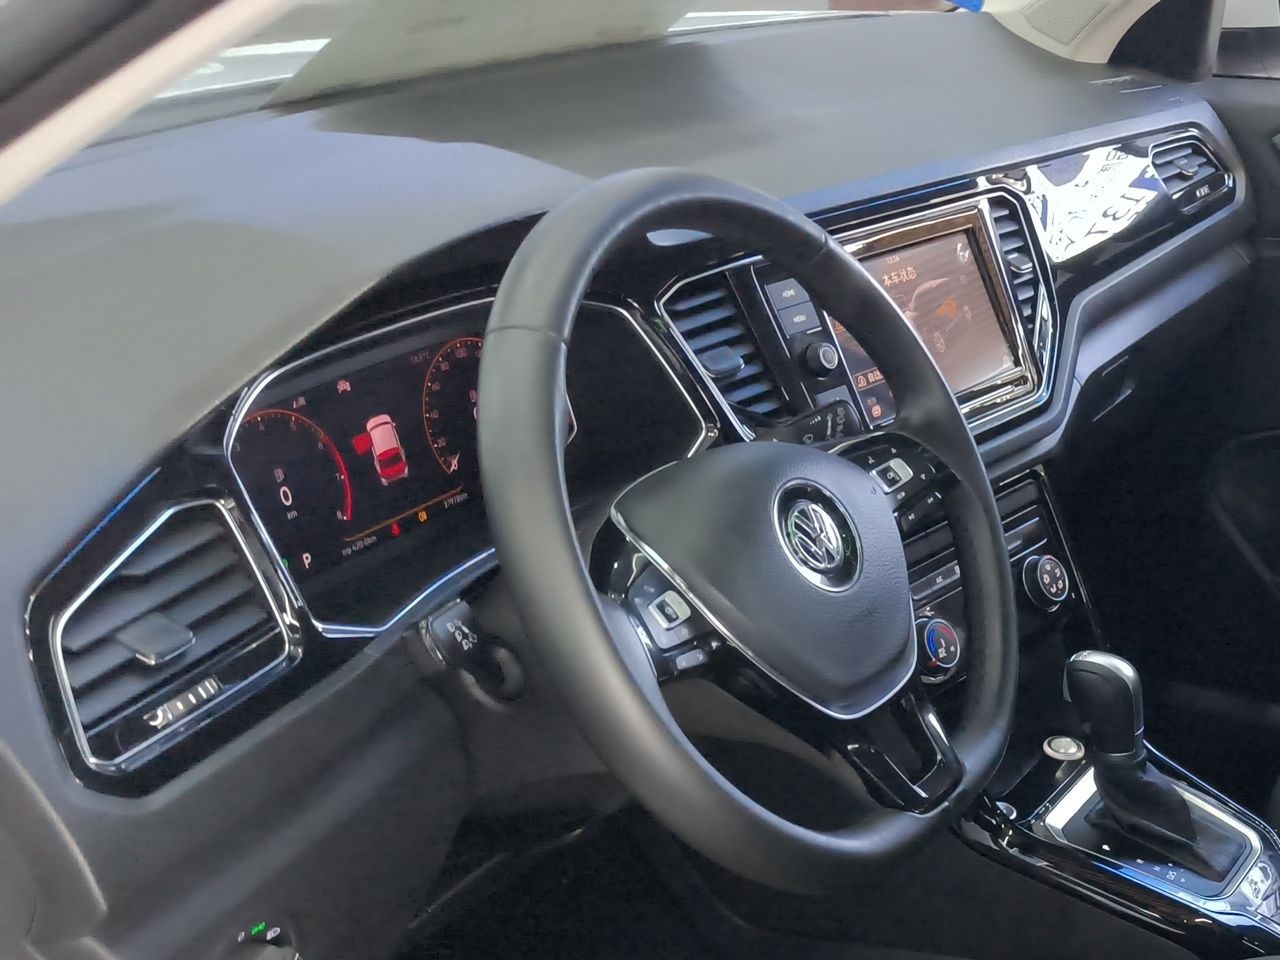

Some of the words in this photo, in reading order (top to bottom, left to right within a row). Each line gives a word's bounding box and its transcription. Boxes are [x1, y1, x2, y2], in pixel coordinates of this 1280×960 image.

[882, 267, 917, 287] 本车状态
[279, 486, 293, 506] 0
[302, 552, 312, 569] P
